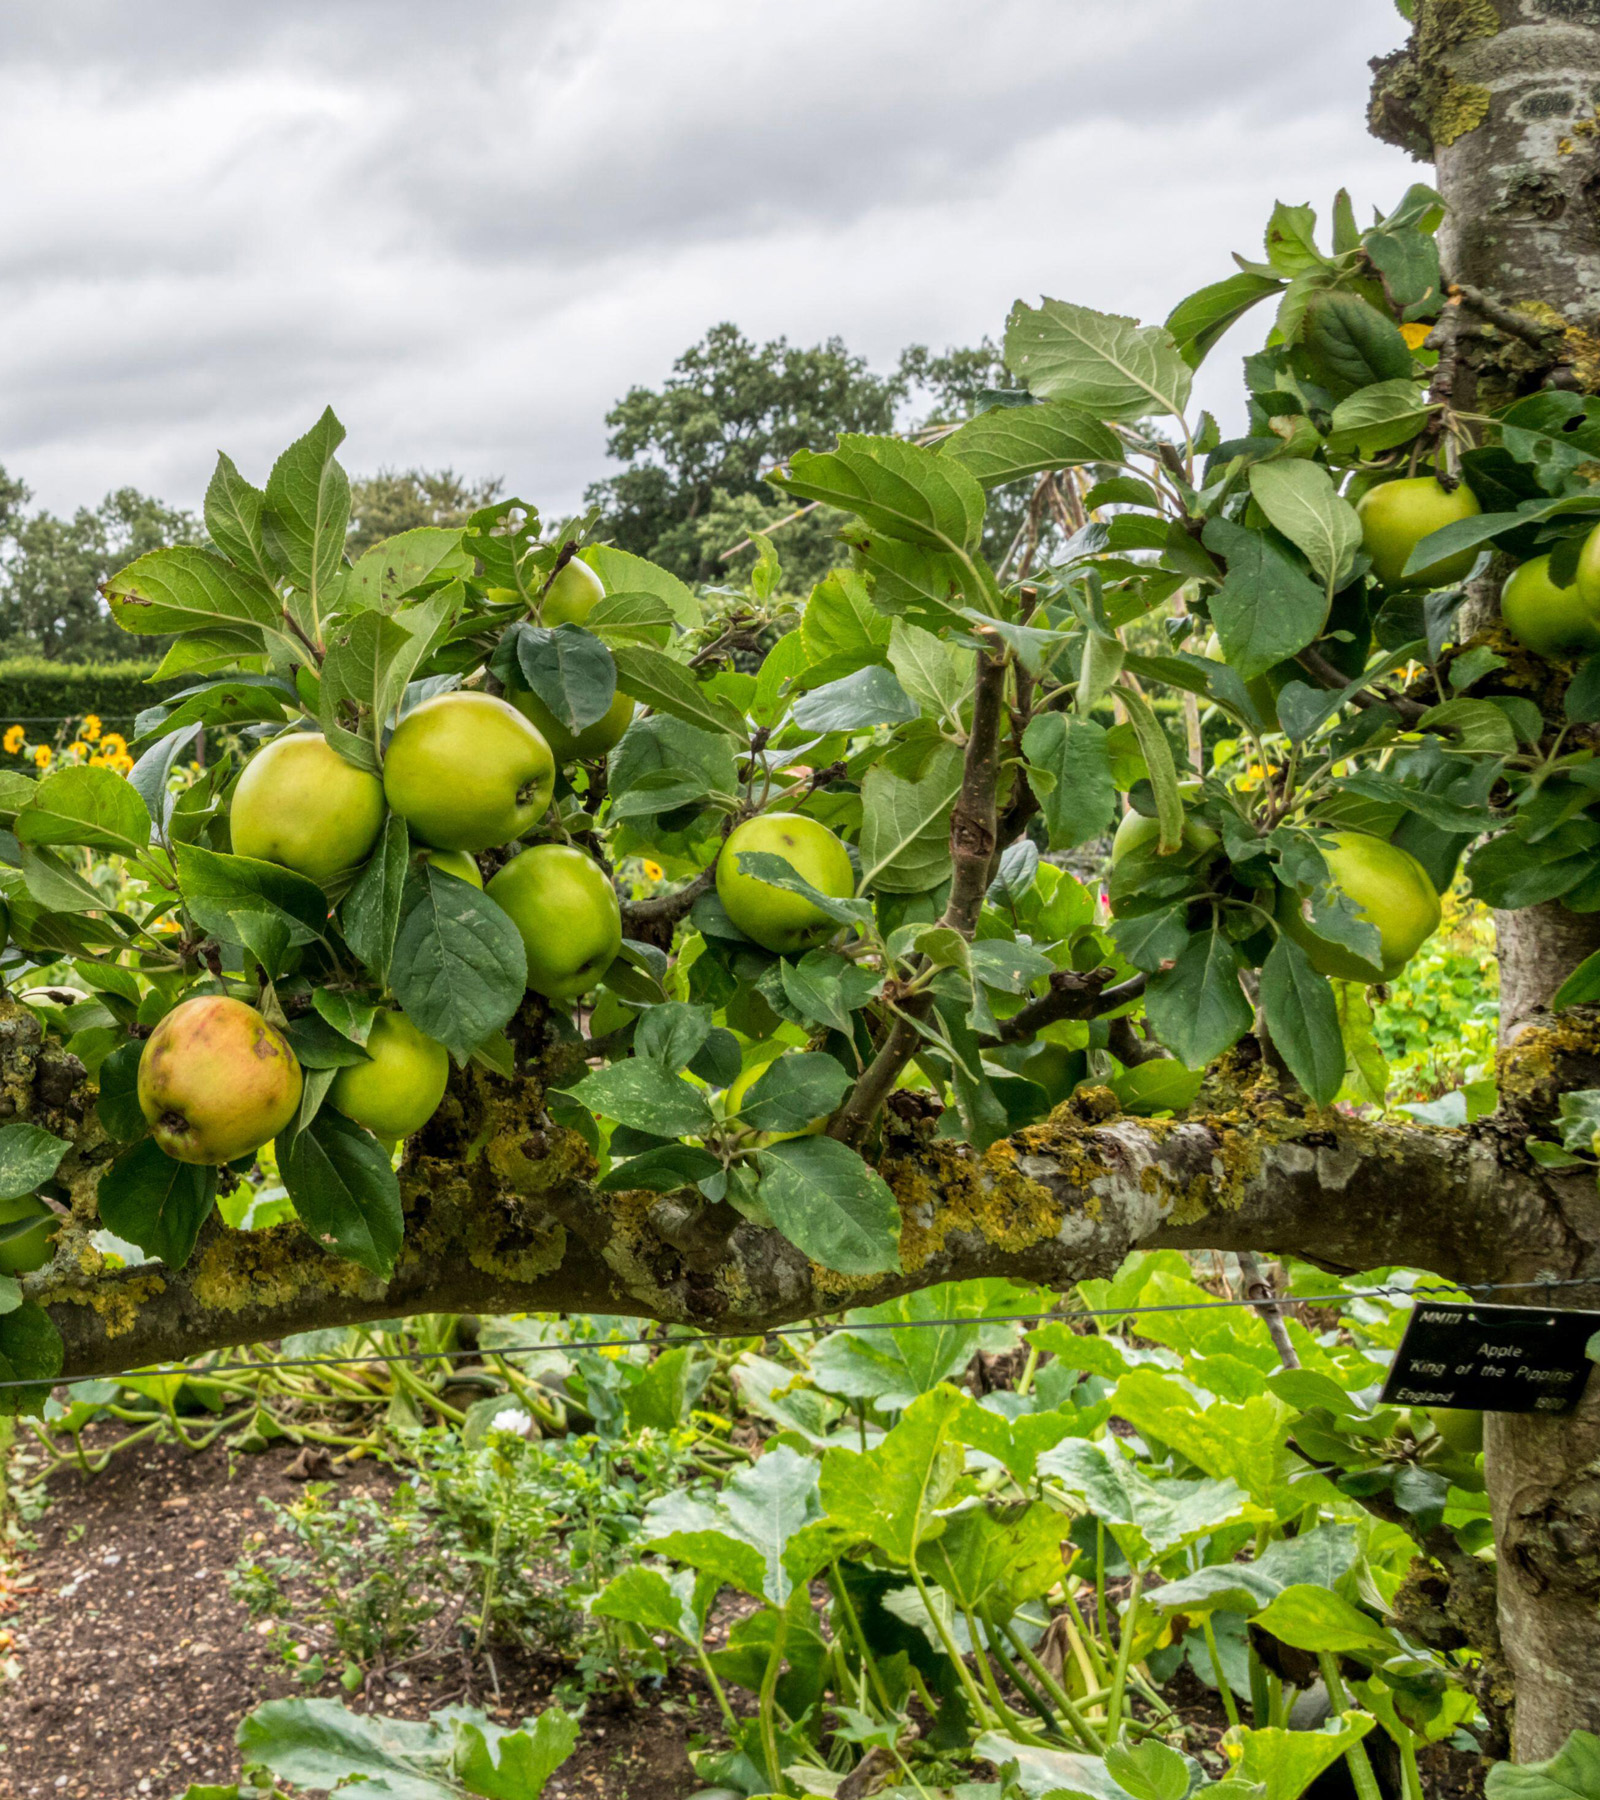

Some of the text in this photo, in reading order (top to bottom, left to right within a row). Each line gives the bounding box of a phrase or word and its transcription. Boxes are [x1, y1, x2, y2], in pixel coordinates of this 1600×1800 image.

[1477, 1342, 1523, 1358] Apple
[1455, 1362, 1474, 1375] of
[1480, 1364, 1506, 1377] the
[1396, 1387, 1455, 1404] England
